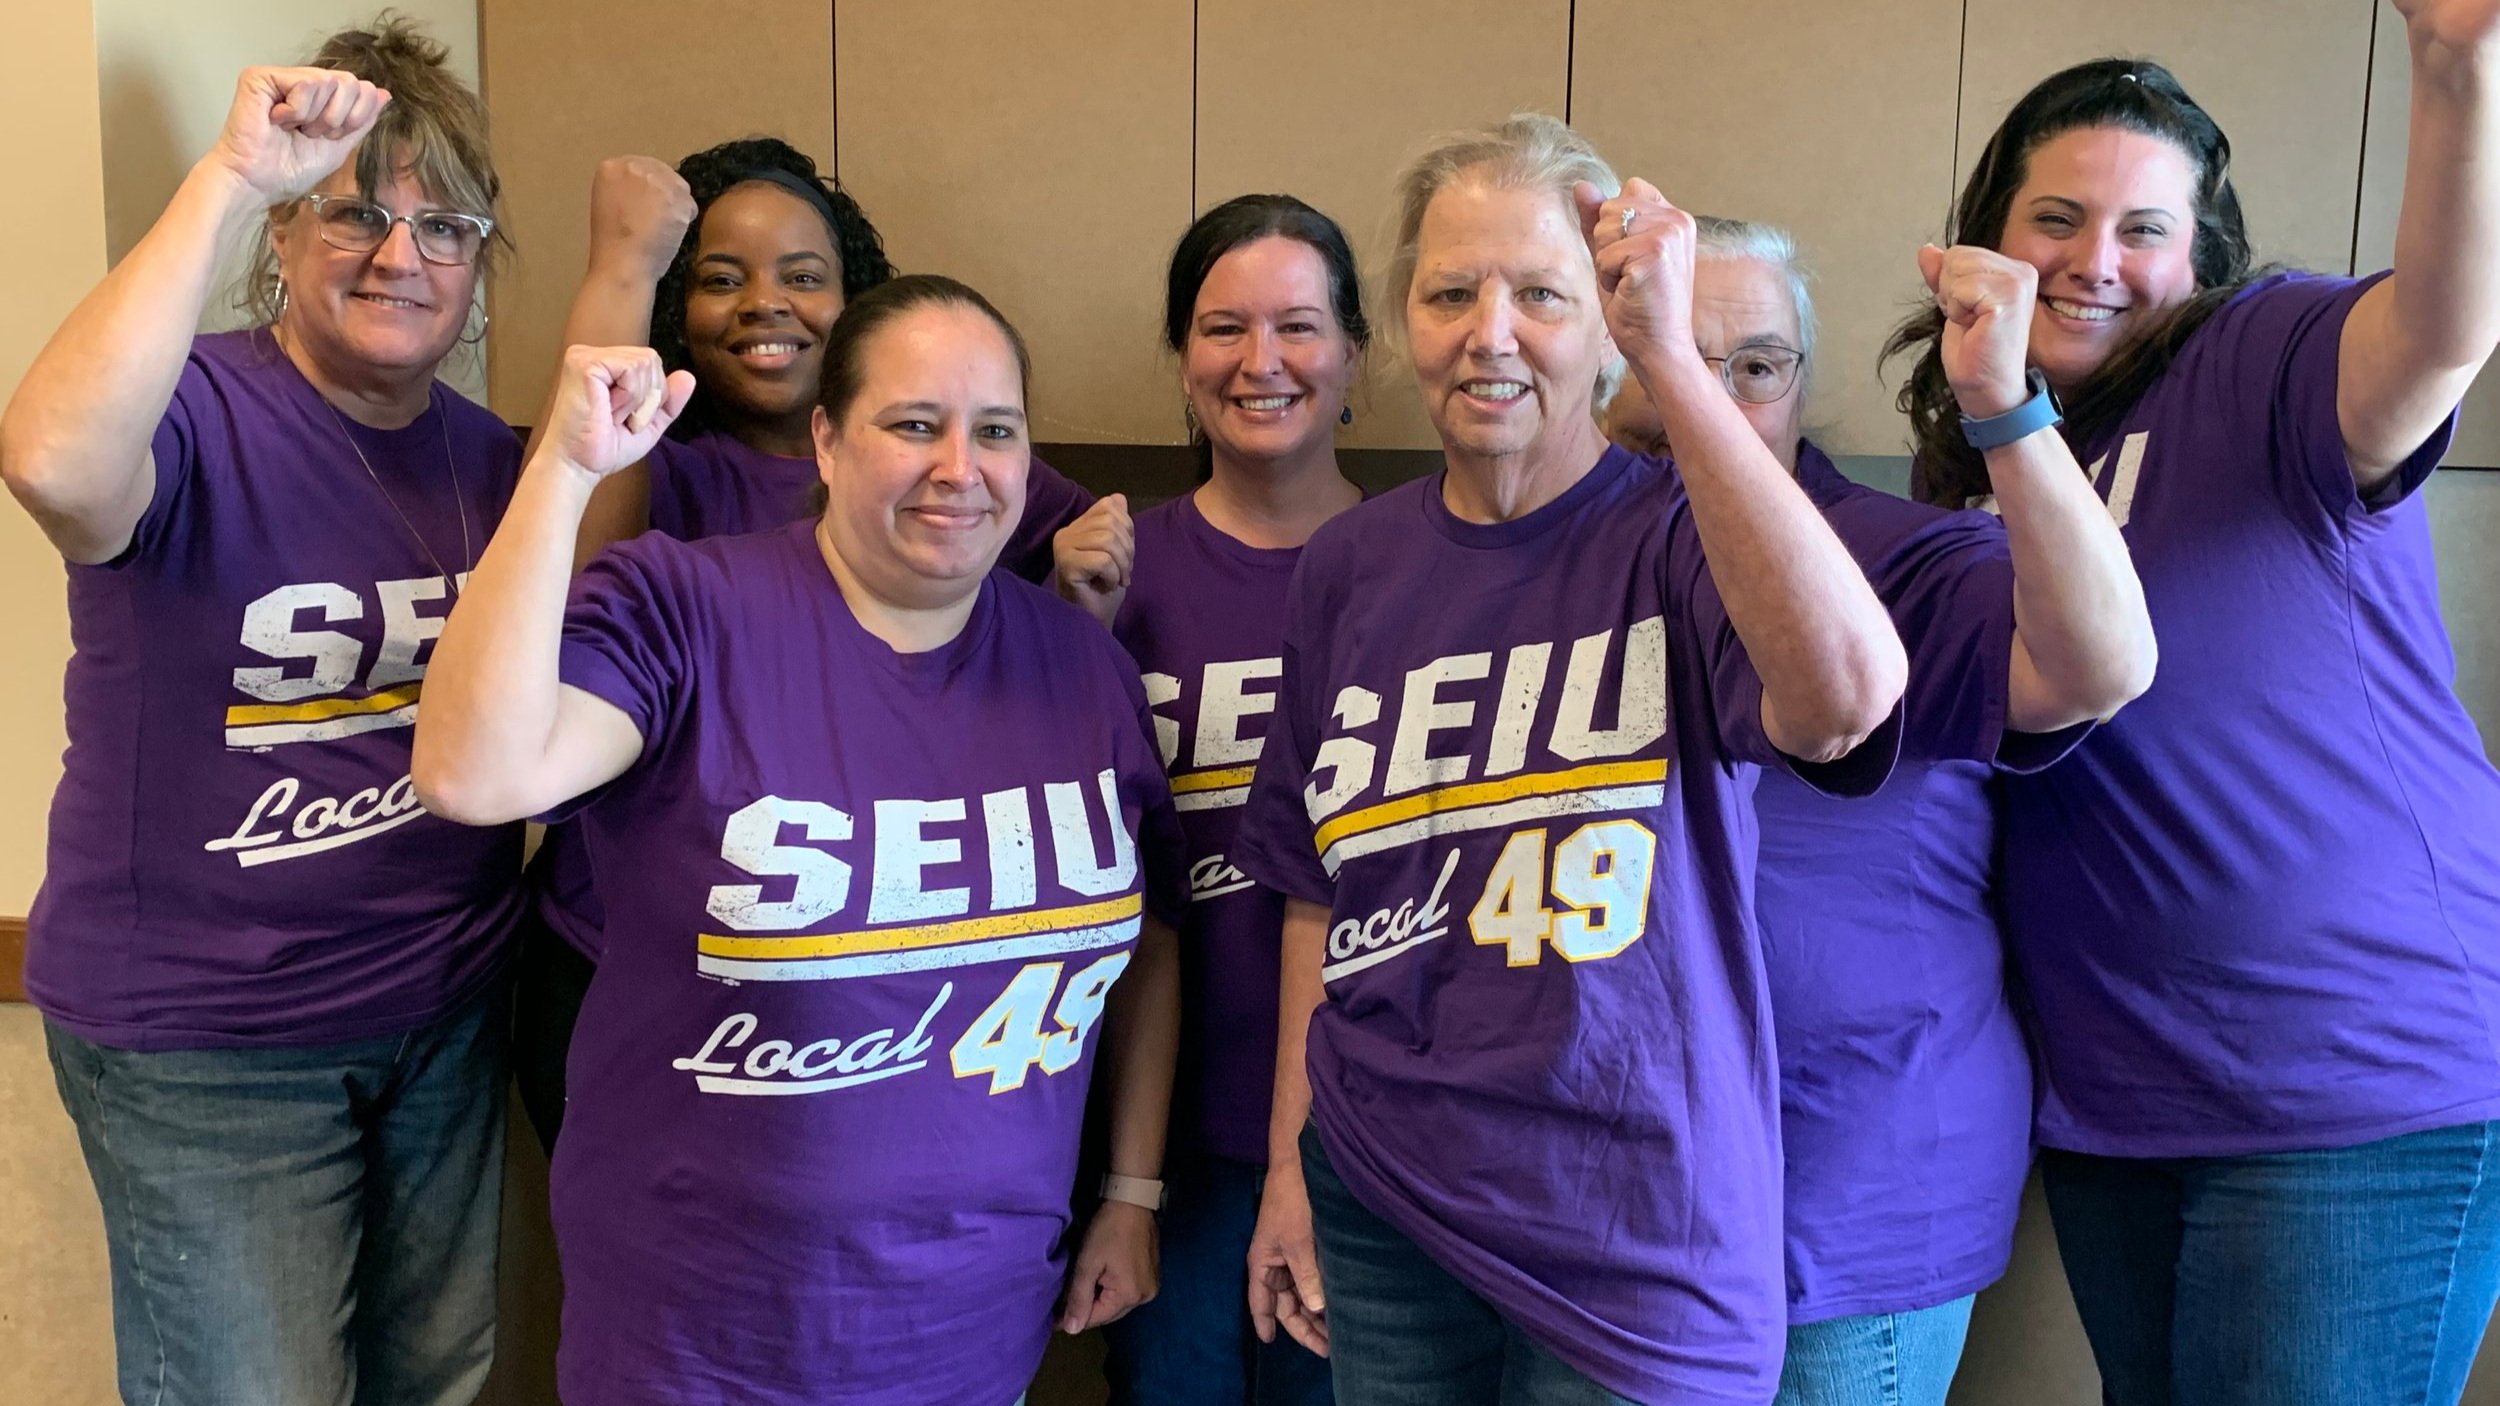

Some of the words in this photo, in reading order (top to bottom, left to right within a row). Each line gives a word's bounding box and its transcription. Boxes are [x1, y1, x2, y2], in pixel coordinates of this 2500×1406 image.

[232, 570, 475, 702] SE
[1304, 614, 1667, 825] SEIU
[204, 773, 419, 851] Loca
[706, 768, 1138, 931] SEIU
[1322, 847, 1449, 963] ocal
[1467, 818, 1656, 968] 49
[672, 981, 953, 1078] Local
[949, 950, 1131, 1096] 49
